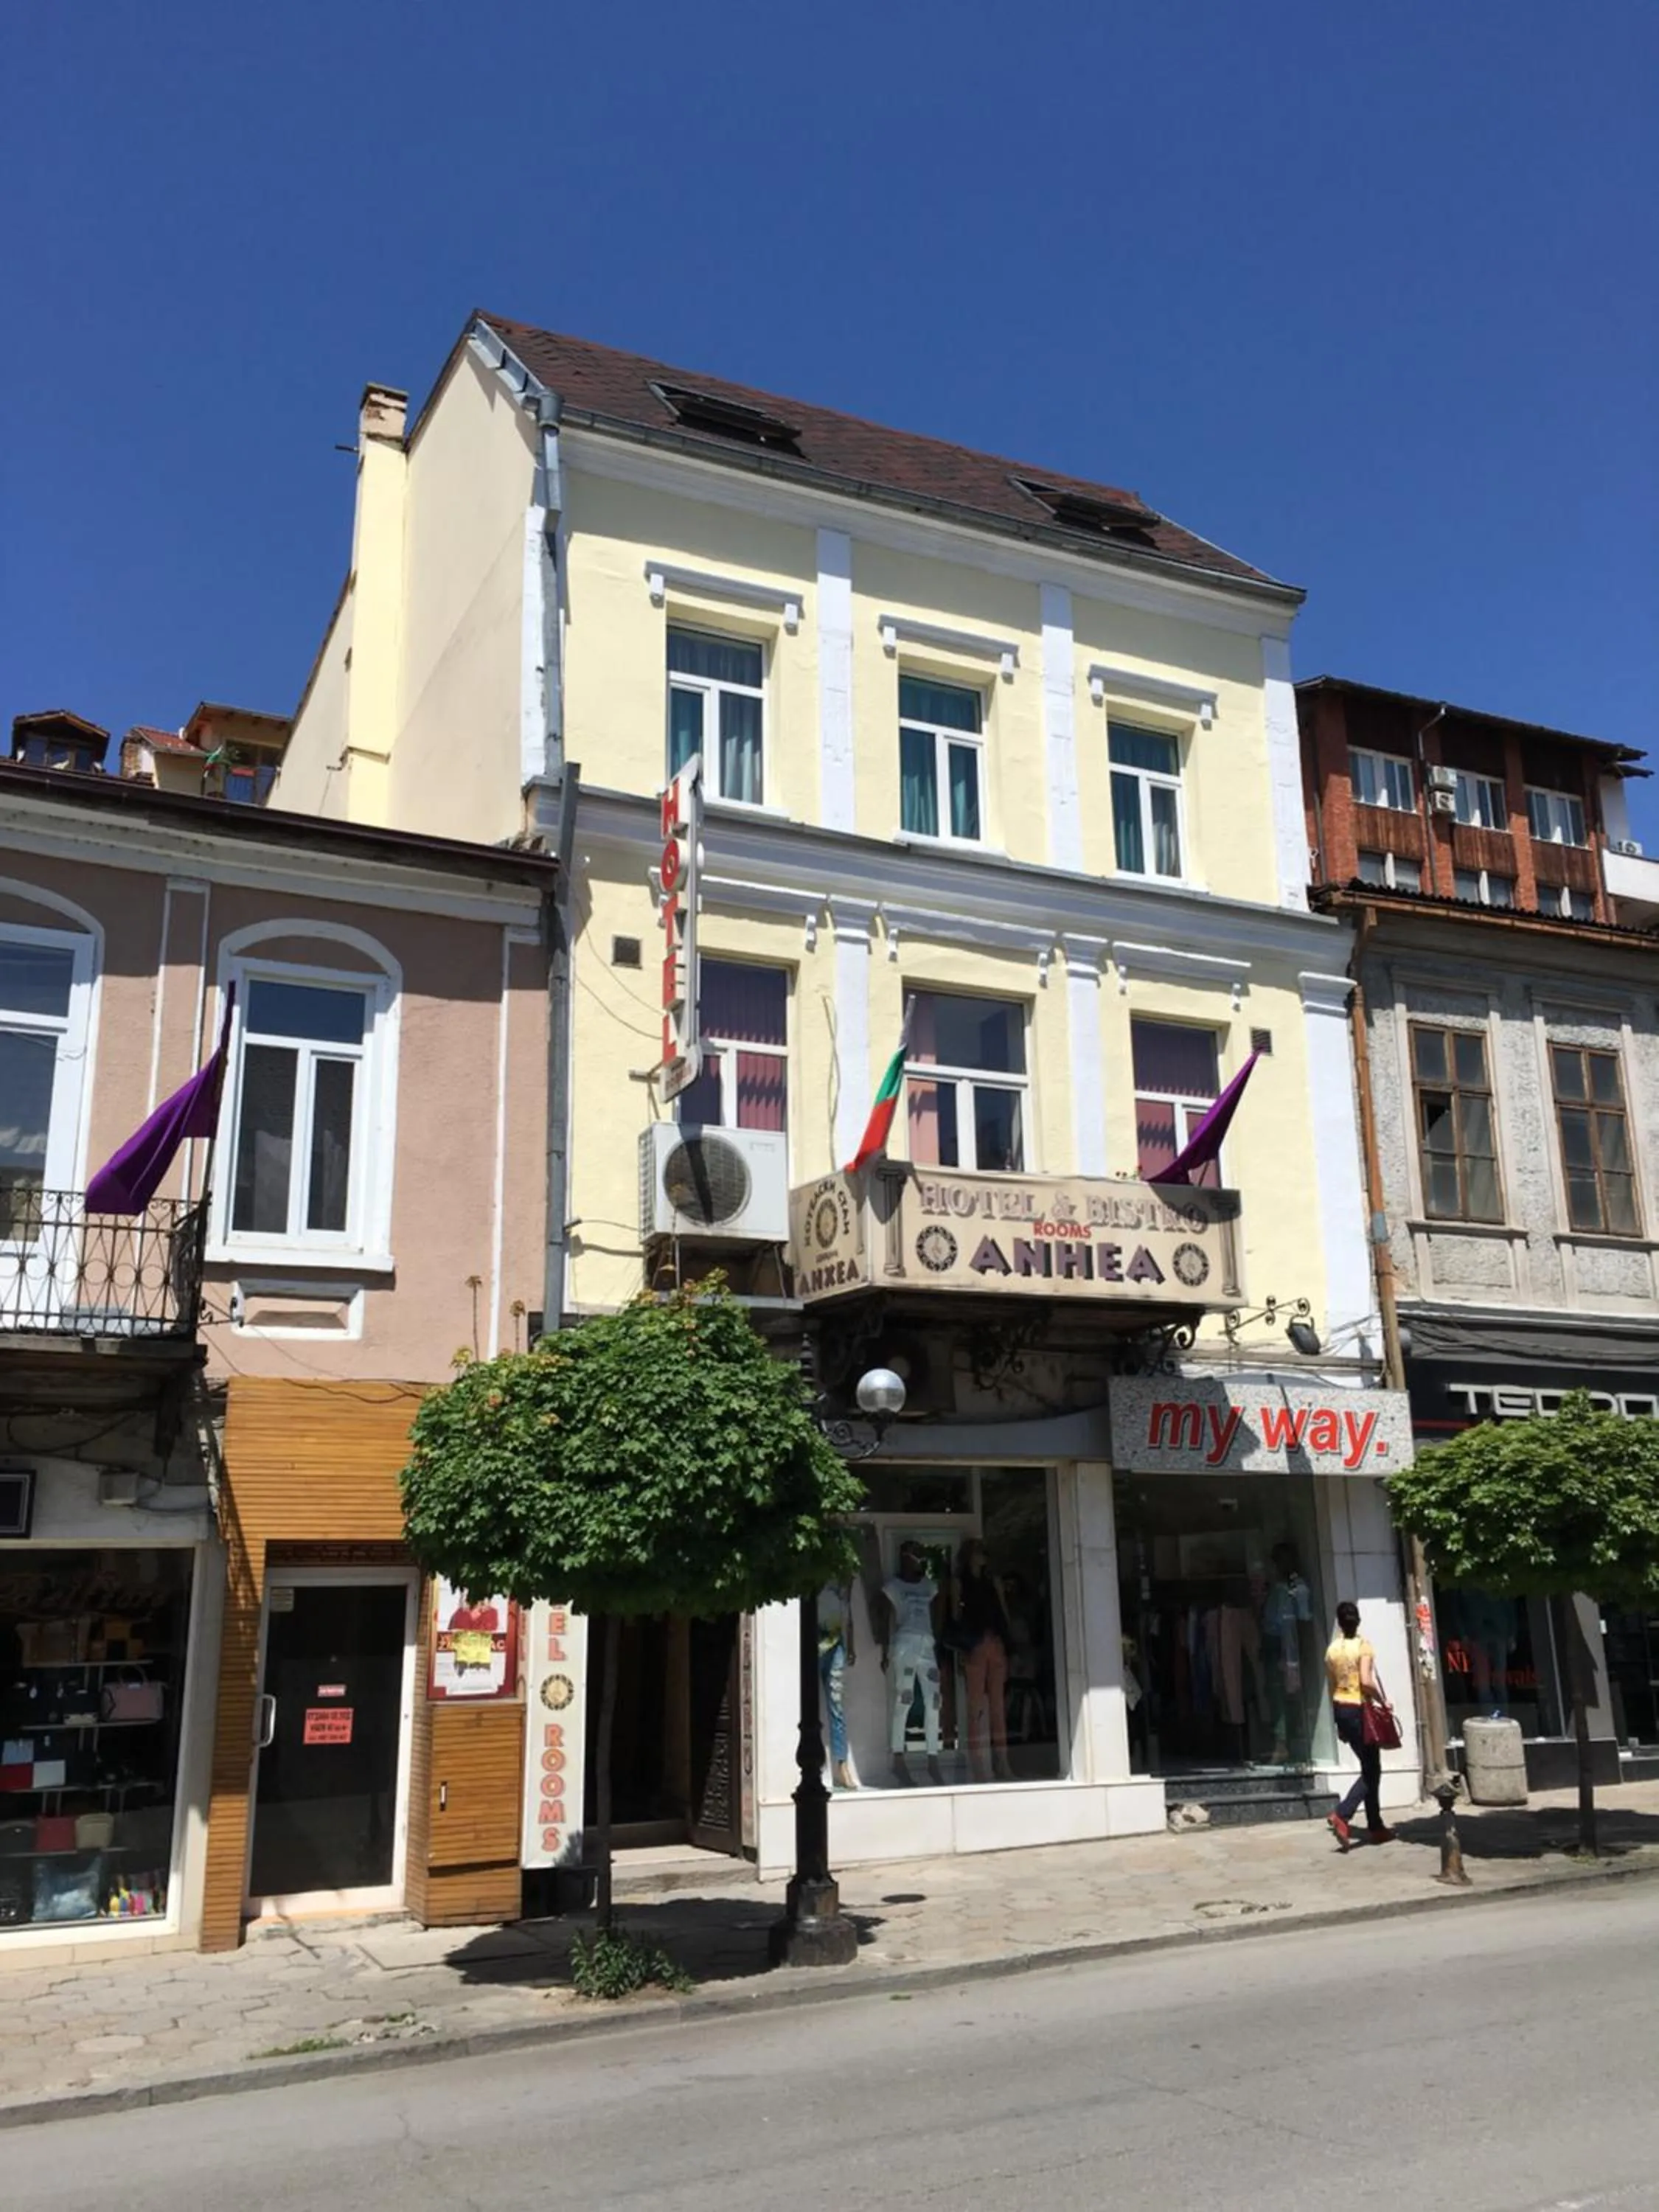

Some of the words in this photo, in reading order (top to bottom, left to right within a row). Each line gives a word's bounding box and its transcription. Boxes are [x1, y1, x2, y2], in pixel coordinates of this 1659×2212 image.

[661, 777, 684, 1067] HOTEL
[921, 1183, 1046, 1222] HOTEL
[1052, 1189, 1077, 1224] &
[1086, 1194, 1208, 1235] BISTRO
[1033, 1221, 1092, 1239] ROOMS
[968, 1234, 1166, 1285] ANHEA
[1147, 1399, 1245, 1467] my
[1260, 1405, 1389, 1470] way.
[548, 1604, 568, 1662] EL
[538, 1722, 566, 1852] ROOMS
